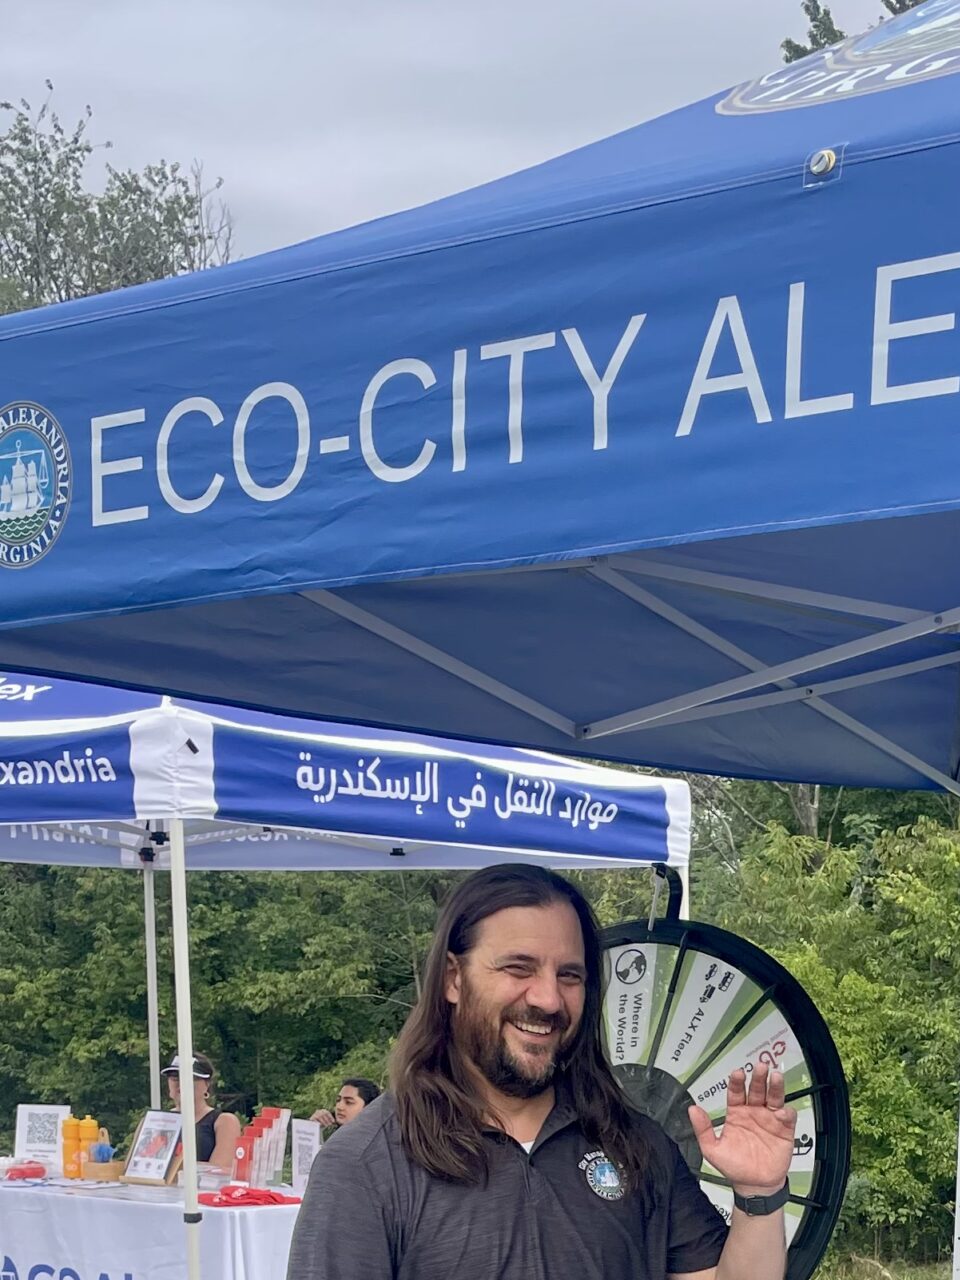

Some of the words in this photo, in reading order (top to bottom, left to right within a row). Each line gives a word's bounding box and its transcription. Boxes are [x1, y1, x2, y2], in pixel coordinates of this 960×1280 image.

[91, 313, 648, 528] ECO-CITY
[296, 751, 439, 815] الإسكندرية
[447, 771, 486, 828] في
[494, 772, 555, 819] النقل
[558, 790, 618, 830] موارد
[619, 993, 628, 1014] the
[631, 992, 643, 1034] Where
[688, 1007, 704, 1032] ALX
[615, 1017, 626, 1060] World?
[630, 1036, 639, 1048] in
[671, 1032, 692, 1062] Fleet
[697, 1079, 728, 1103] Rides
